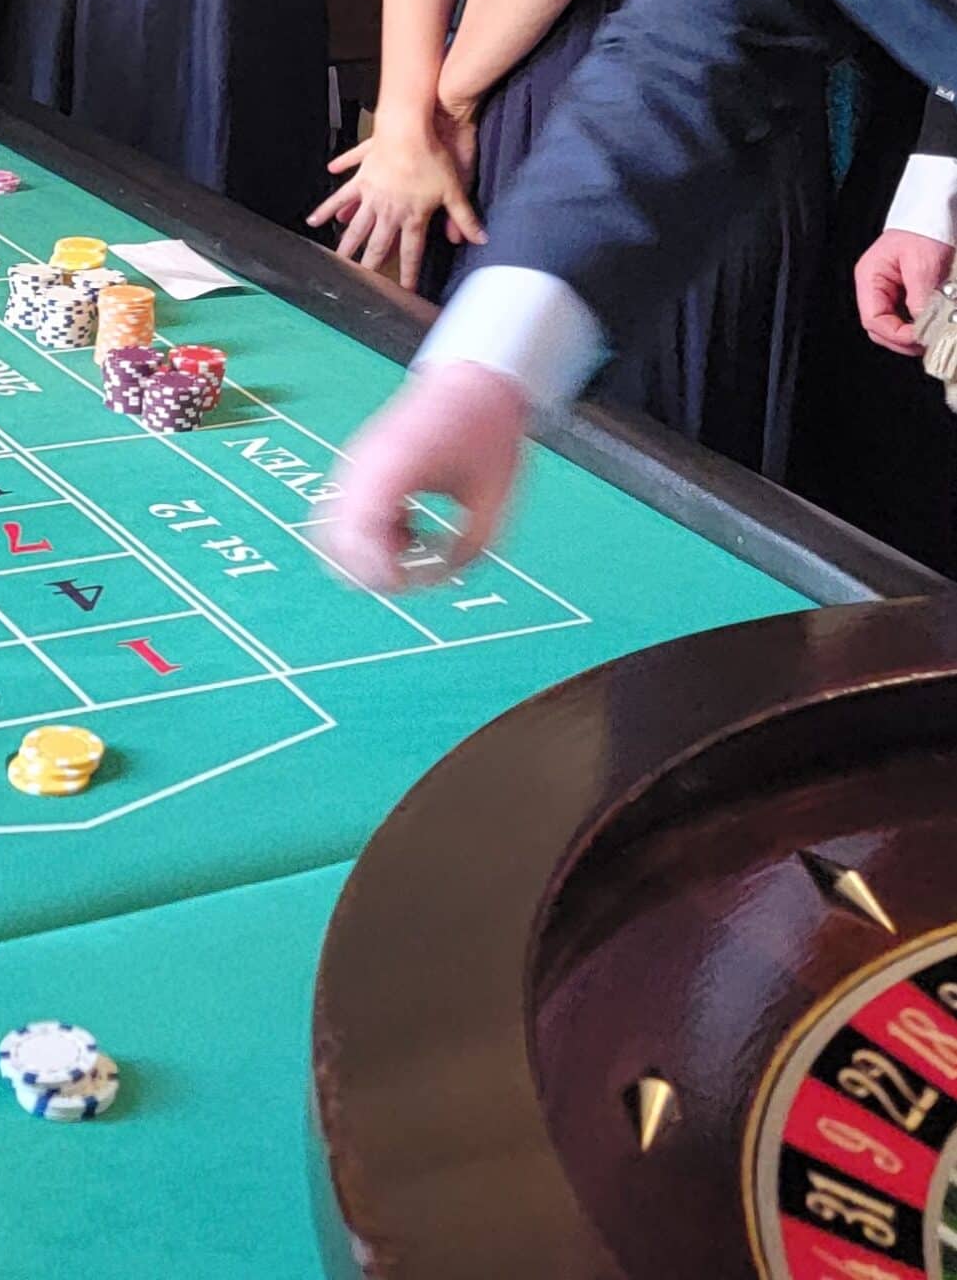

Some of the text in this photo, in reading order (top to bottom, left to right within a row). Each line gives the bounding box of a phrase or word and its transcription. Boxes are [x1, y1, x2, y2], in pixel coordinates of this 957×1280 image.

[221, 436, 347, 505] EVEN
[3, 521, 53, 555] 7
[148, 499, 280, 579] 1st 12
[43, 577, 104, 613] 4
[117, 637, 184, 676] 1
[887, 1006, 957, 1081] 18
[837, 1047, 940, 1132] 22
[816, 1117, 902, 1174] 9
[805, 1169, 896, 1248] 31
